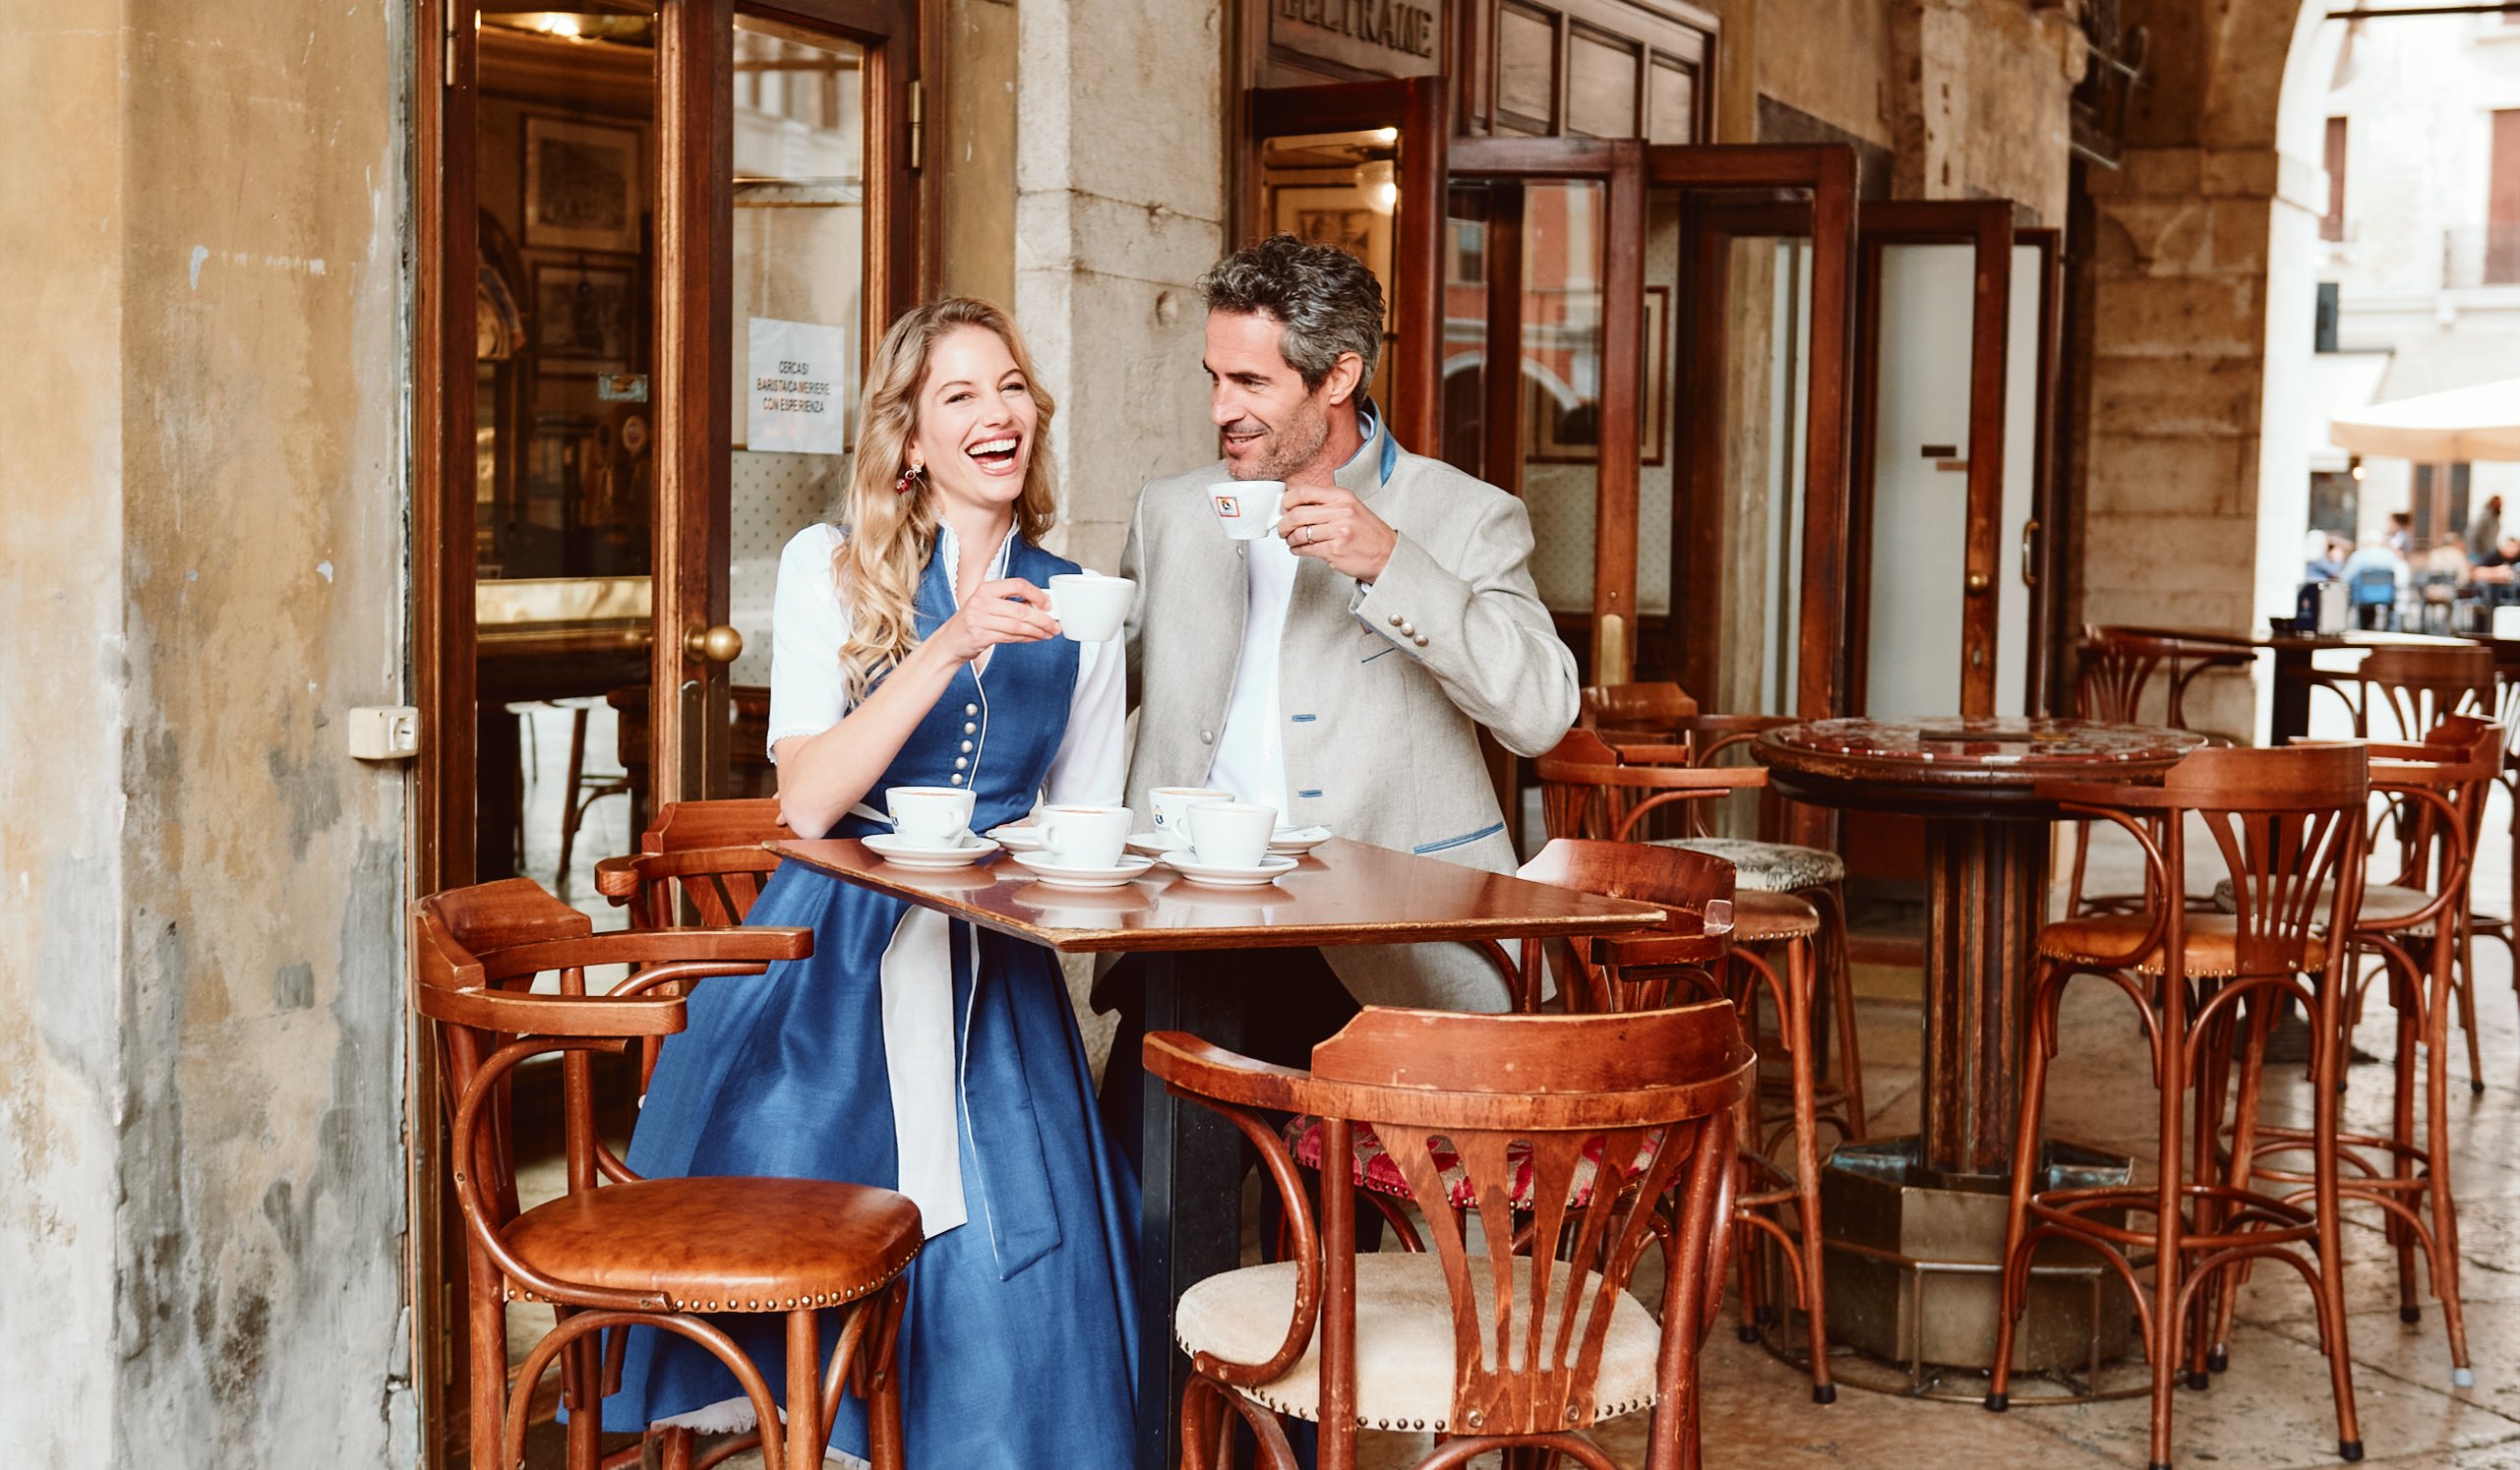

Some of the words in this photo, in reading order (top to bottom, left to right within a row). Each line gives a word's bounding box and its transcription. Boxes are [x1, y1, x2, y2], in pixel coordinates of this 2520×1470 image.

[779, 360, 810, 376] CERCASI
[763, 397, 779, 411] CON
[780, 398, 825, 413] ESPERIENZA
